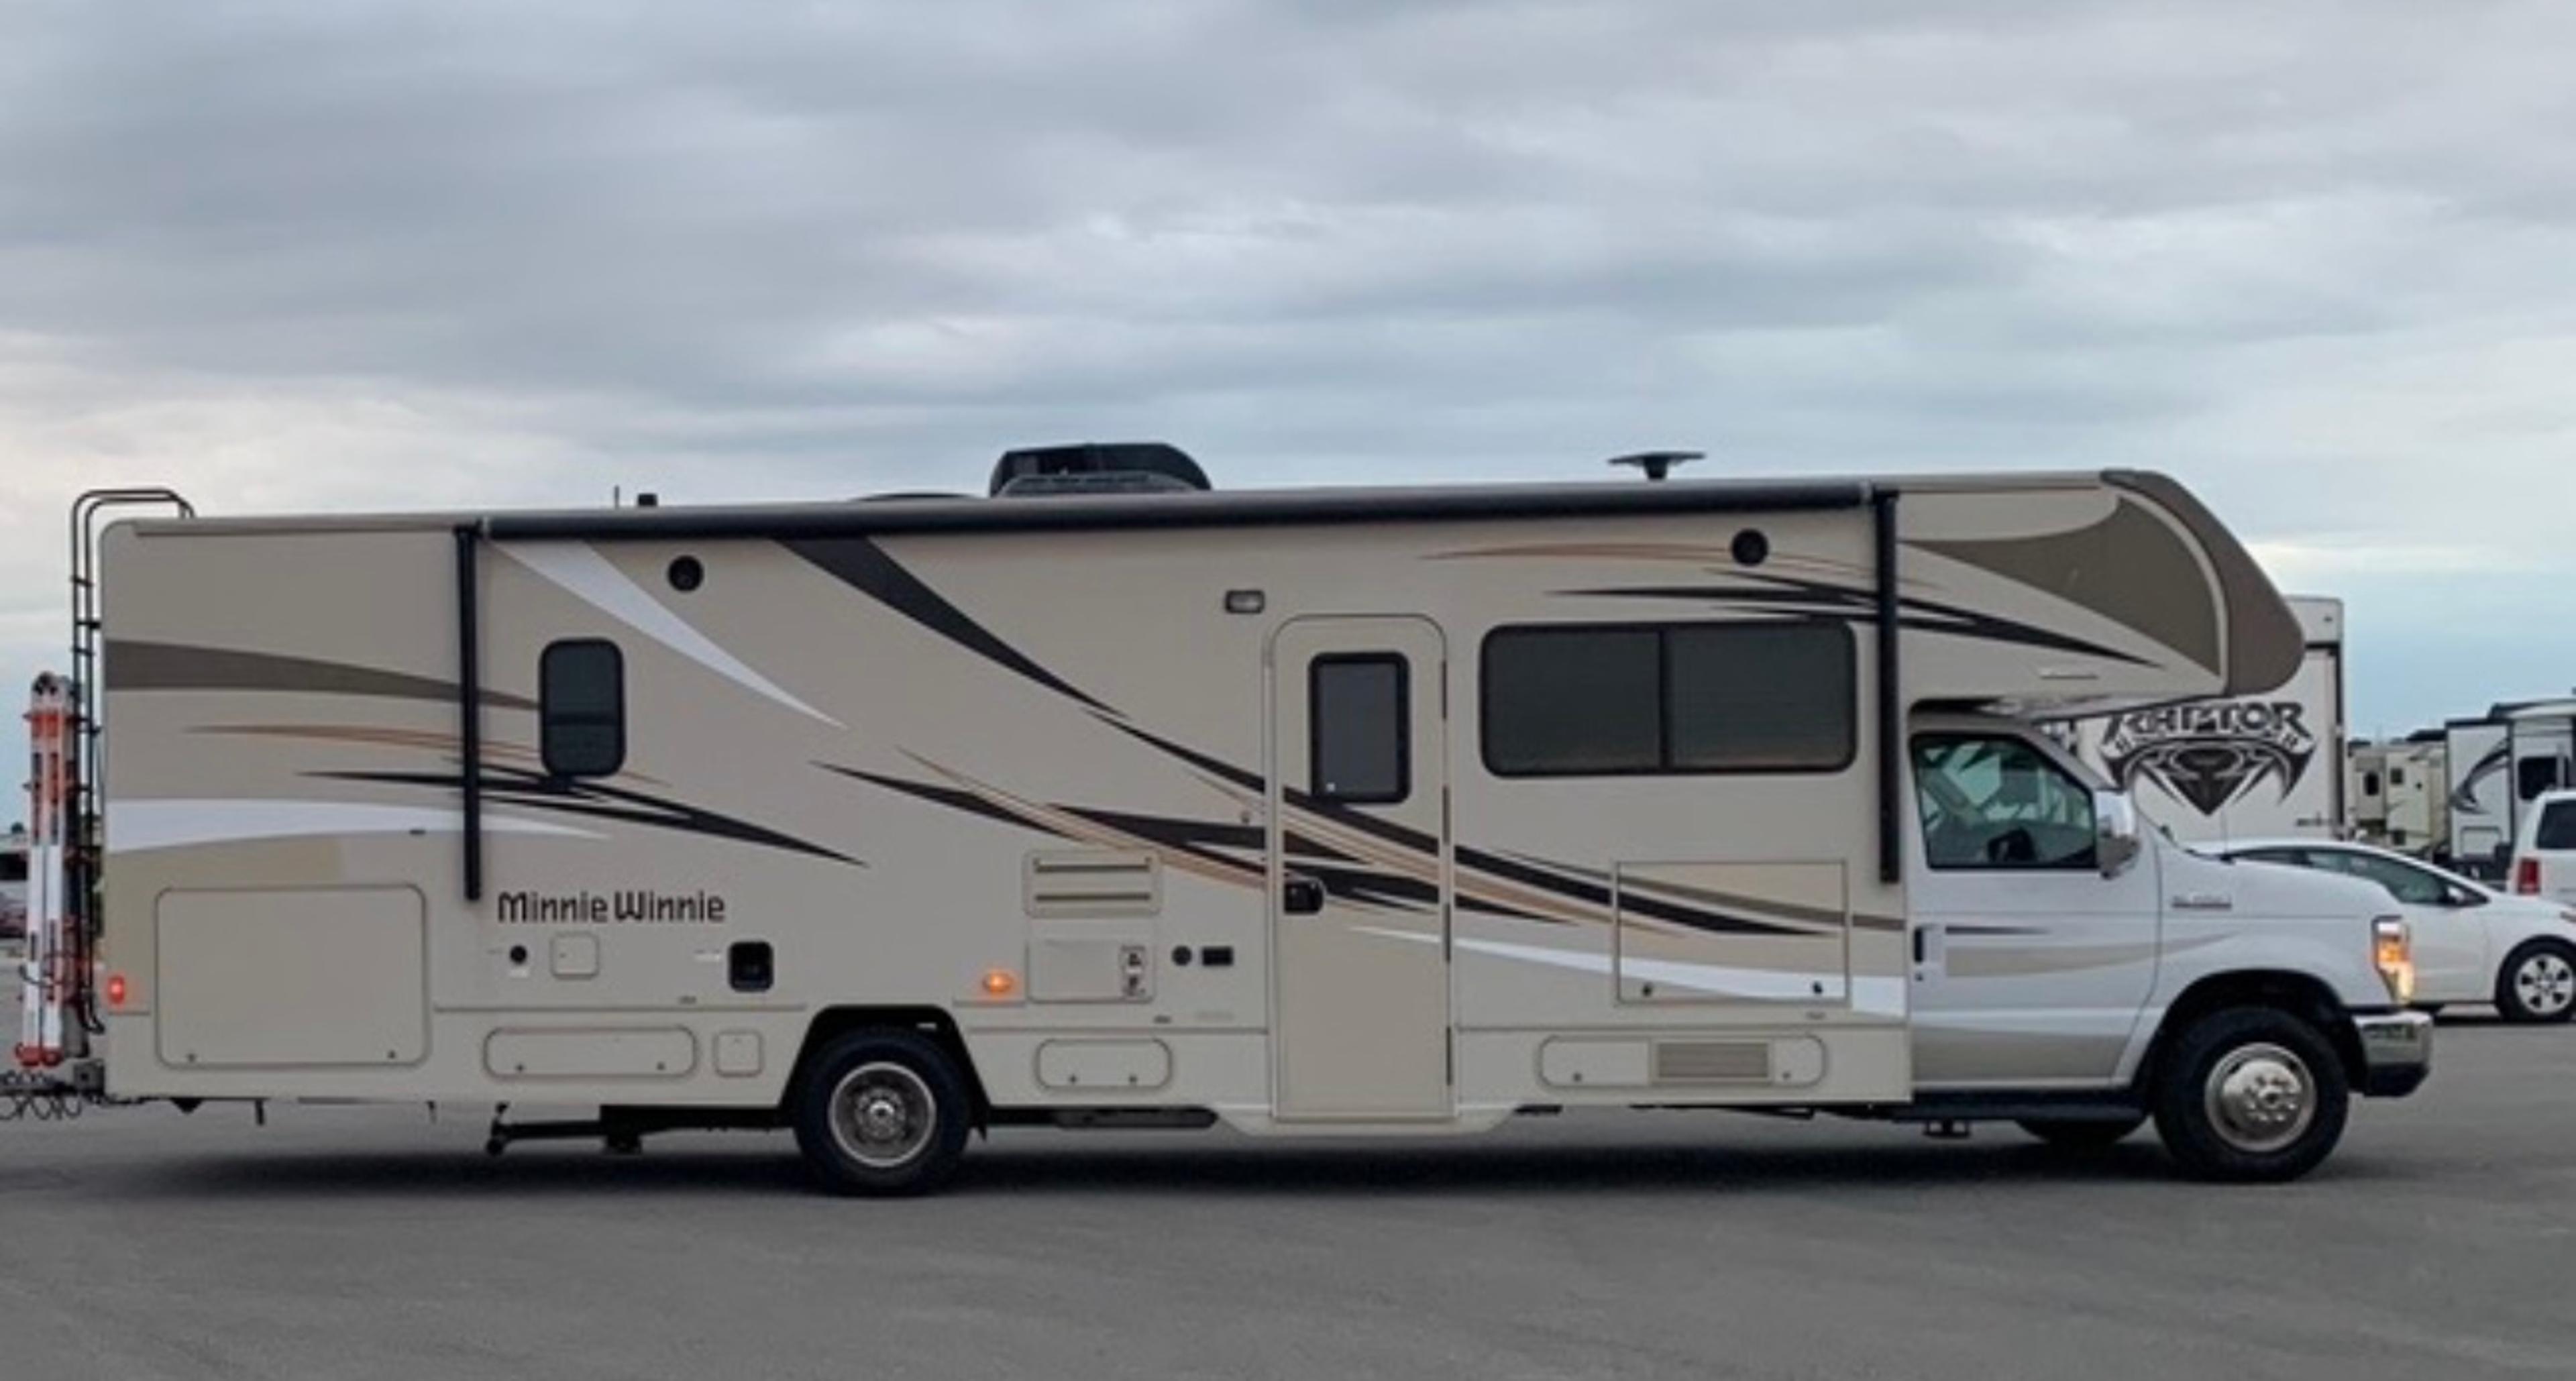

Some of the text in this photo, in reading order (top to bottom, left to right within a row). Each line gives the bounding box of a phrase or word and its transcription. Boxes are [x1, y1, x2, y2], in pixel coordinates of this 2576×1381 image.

[2102, 702, 2312, 744] RAPTOR
[498, 889, 725, 922] Minnie Winnie
